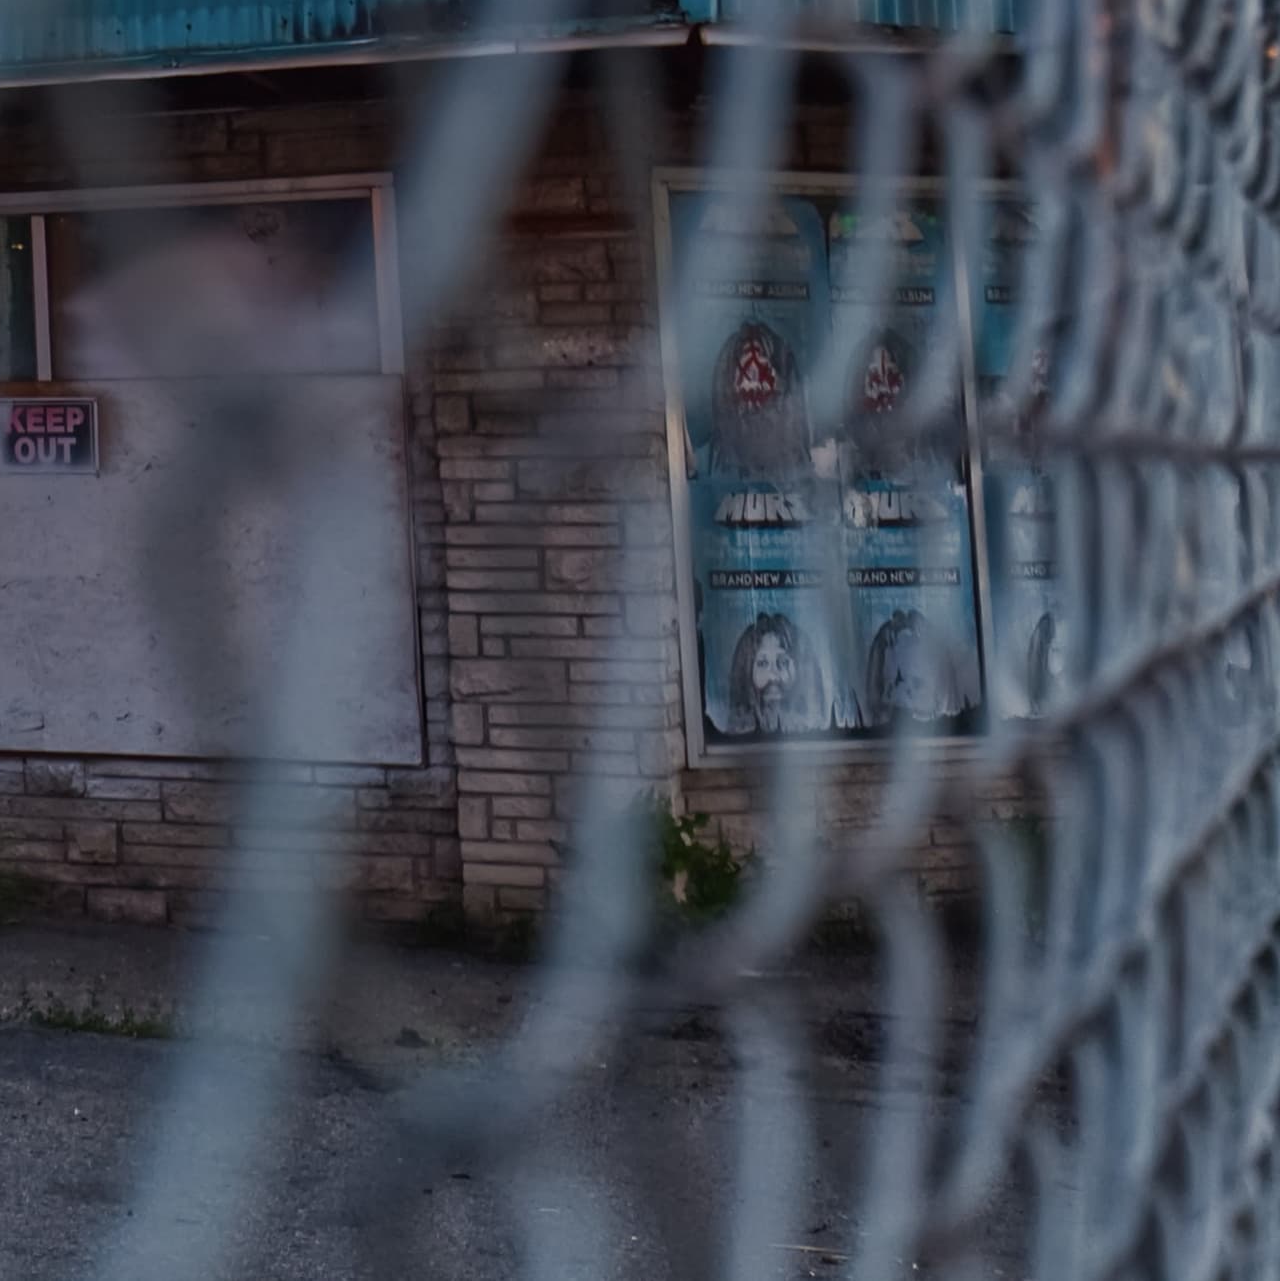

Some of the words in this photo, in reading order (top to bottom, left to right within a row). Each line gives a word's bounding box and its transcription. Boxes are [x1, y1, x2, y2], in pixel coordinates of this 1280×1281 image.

[5, 406, 85, 434] KEEP
[14, 436, 77, 464] OUT
[713, 493, 812, 522] MURS
[712, 572, 752, 587] BRAND
[754, 572, 780, 586] NEW
[848, 571, 887, 584] BRAND
[890, 571, 915, 584] NEW
